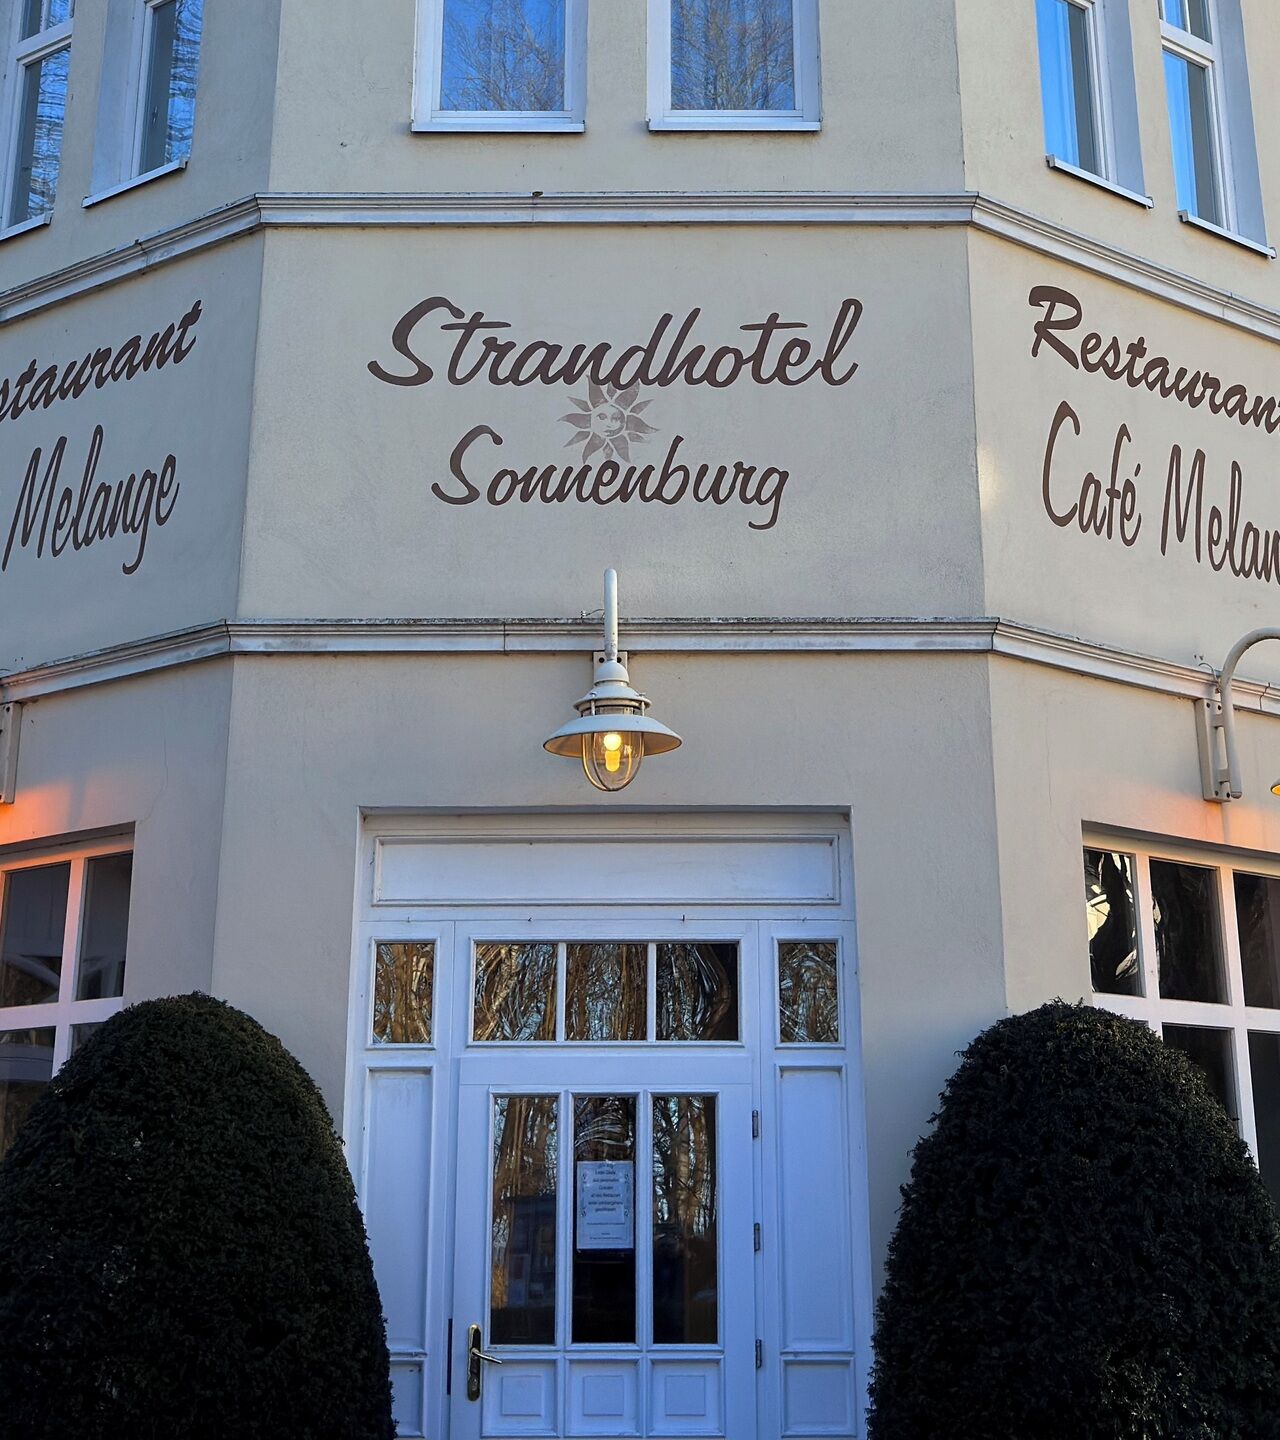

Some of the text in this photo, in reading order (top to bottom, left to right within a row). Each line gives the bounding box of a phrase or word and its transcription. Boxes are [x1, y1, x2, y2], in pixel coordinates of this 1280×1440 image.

[367, 296, 863, 388] Strandhotel
[1, 424, 181, 576] Melange
[431, 424, 790, 531] Sonnenburg
[1041, 400, 1142, 547] Café
